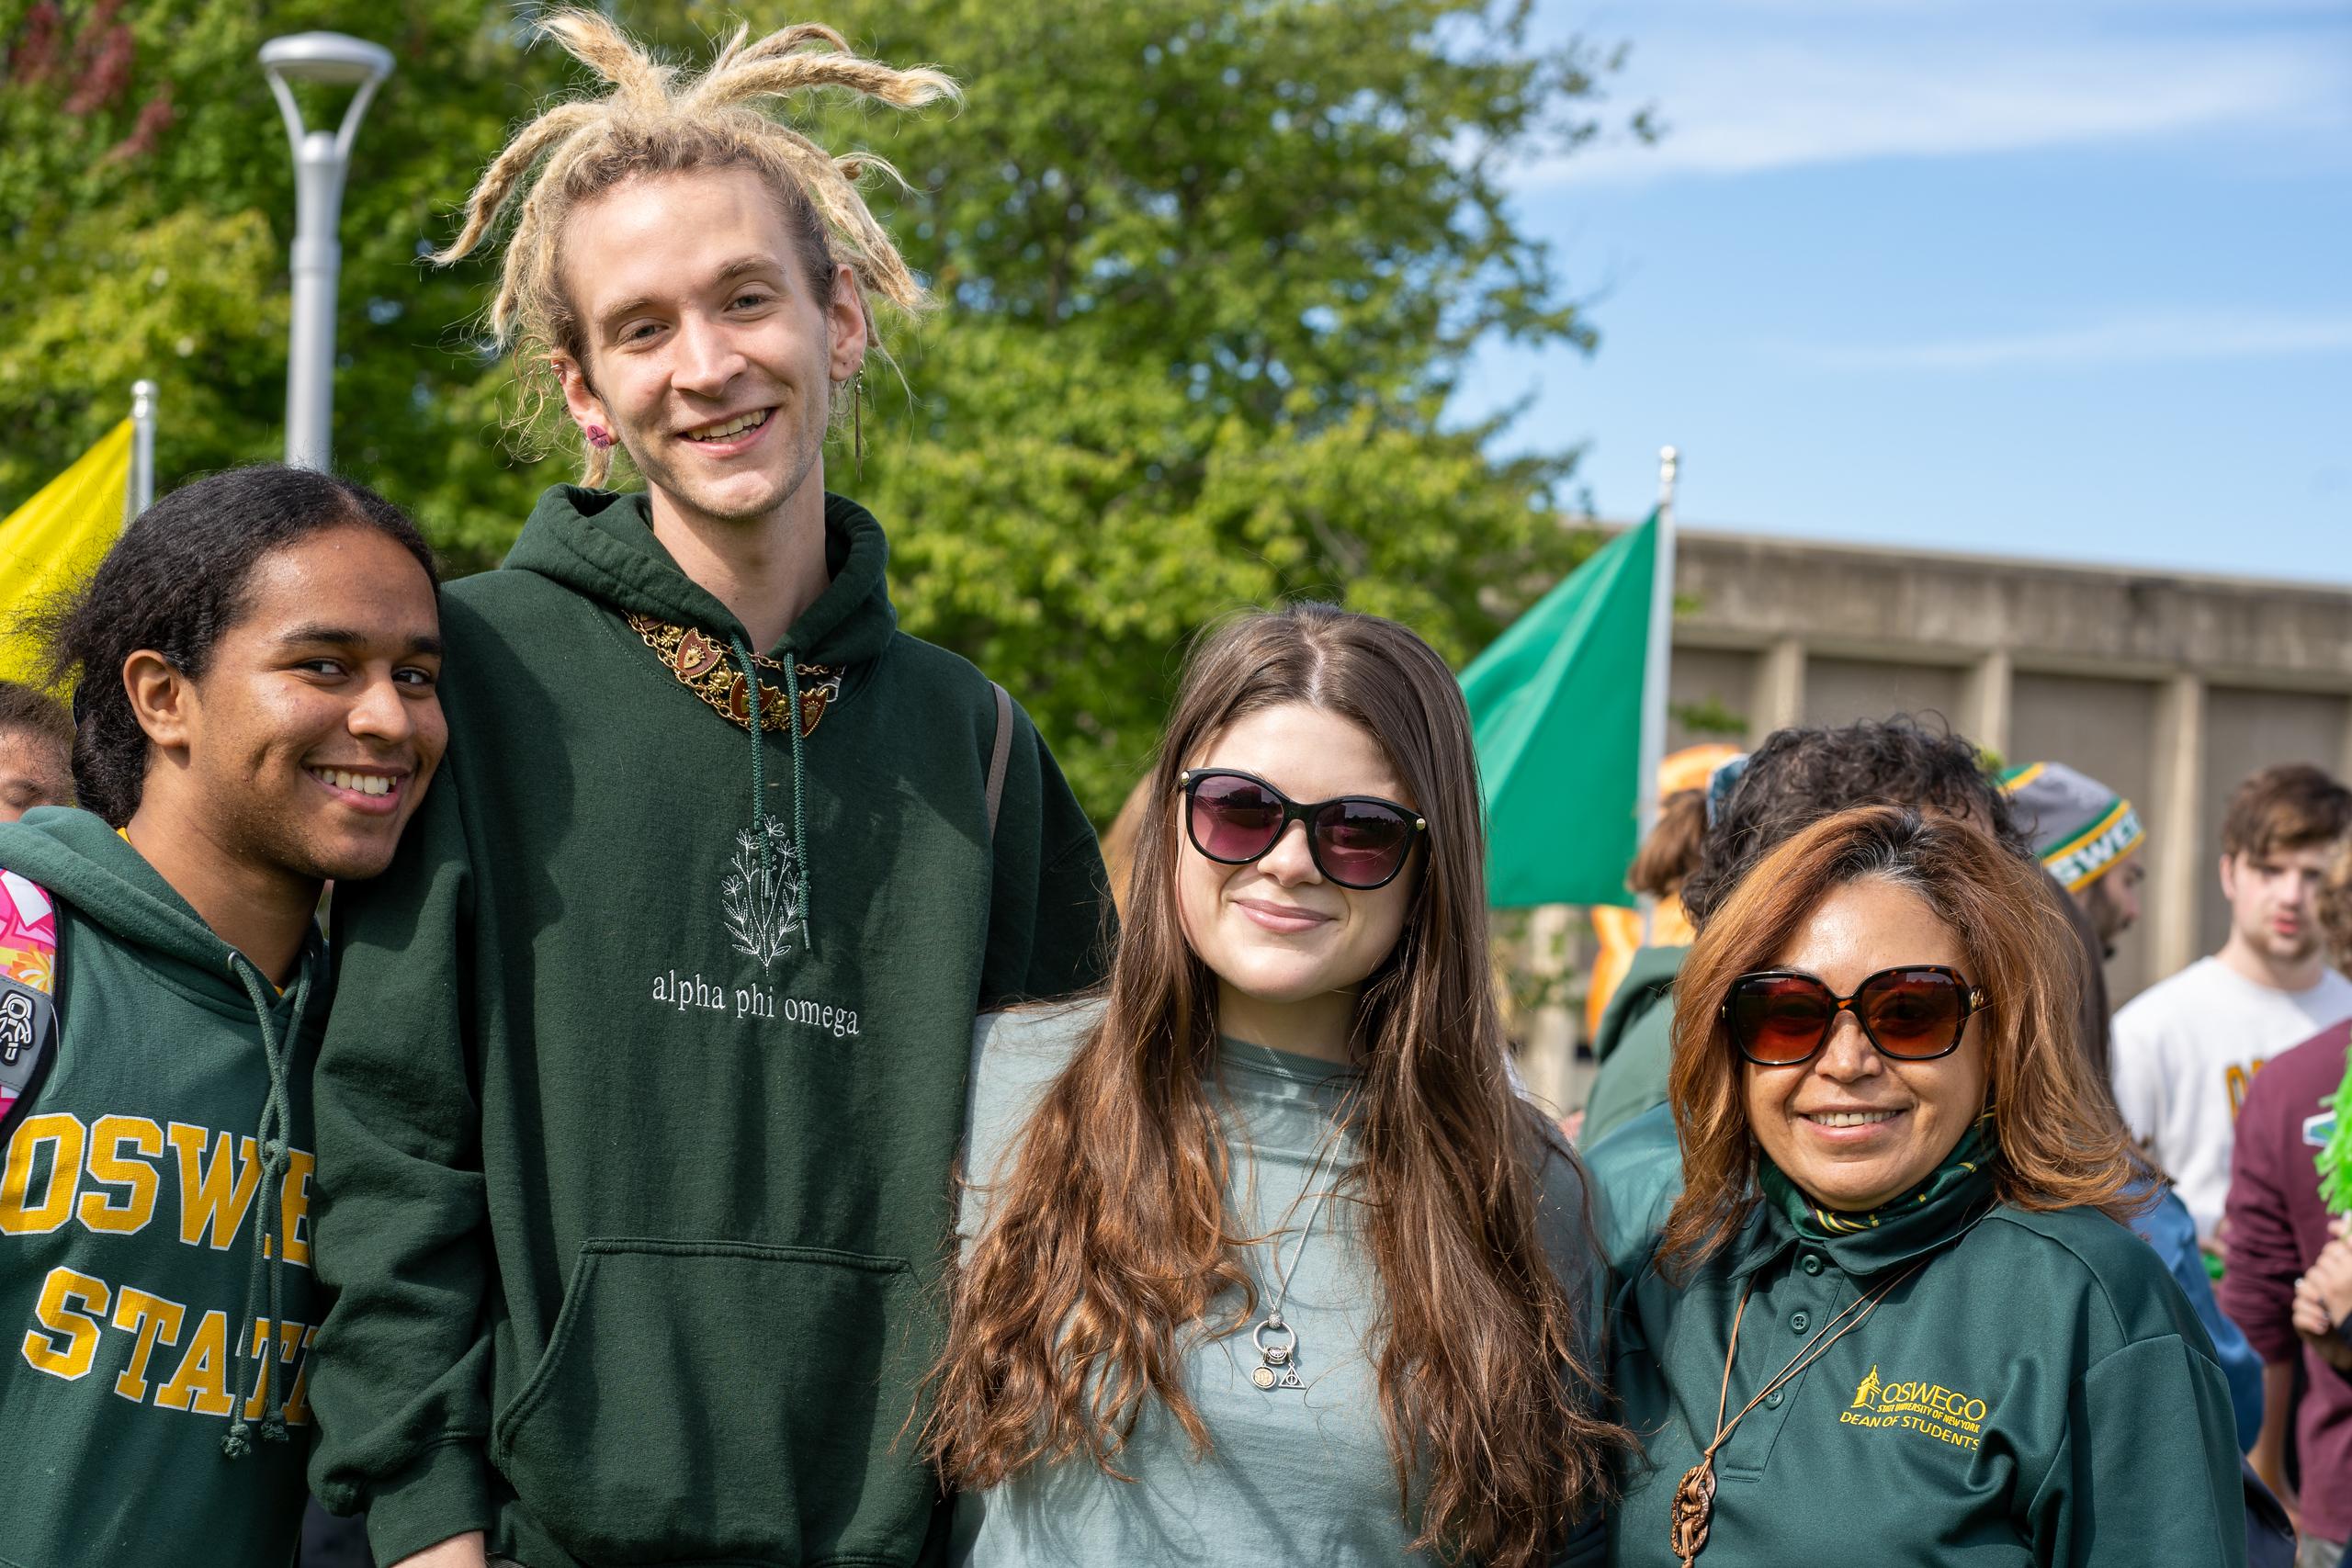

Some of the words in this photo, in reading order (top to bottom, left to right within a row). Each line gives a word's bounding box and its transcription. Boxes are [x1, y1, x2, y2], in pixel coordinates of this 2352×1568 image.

[652, 969, 726, 1010] alpha
[735, 983, 775, 1019] phi
[785, 997, 860, 1037] omega
[1882, 1382, 1986, 1421] OSWEGO
[1894, 1402, 1932, 1416] UNIVERSITY
[1932, 1410, 1944, 1420] OF
[1942, 1414, 1961, 1427] NEW
[1960, 1419, 1981, 1433] YORK
[1840, 1412, 1882, 1427] DEAN
[1882, 1416, 1900, 1427] OF
[1901, 1416, 1980, 1450] STUDENTS
